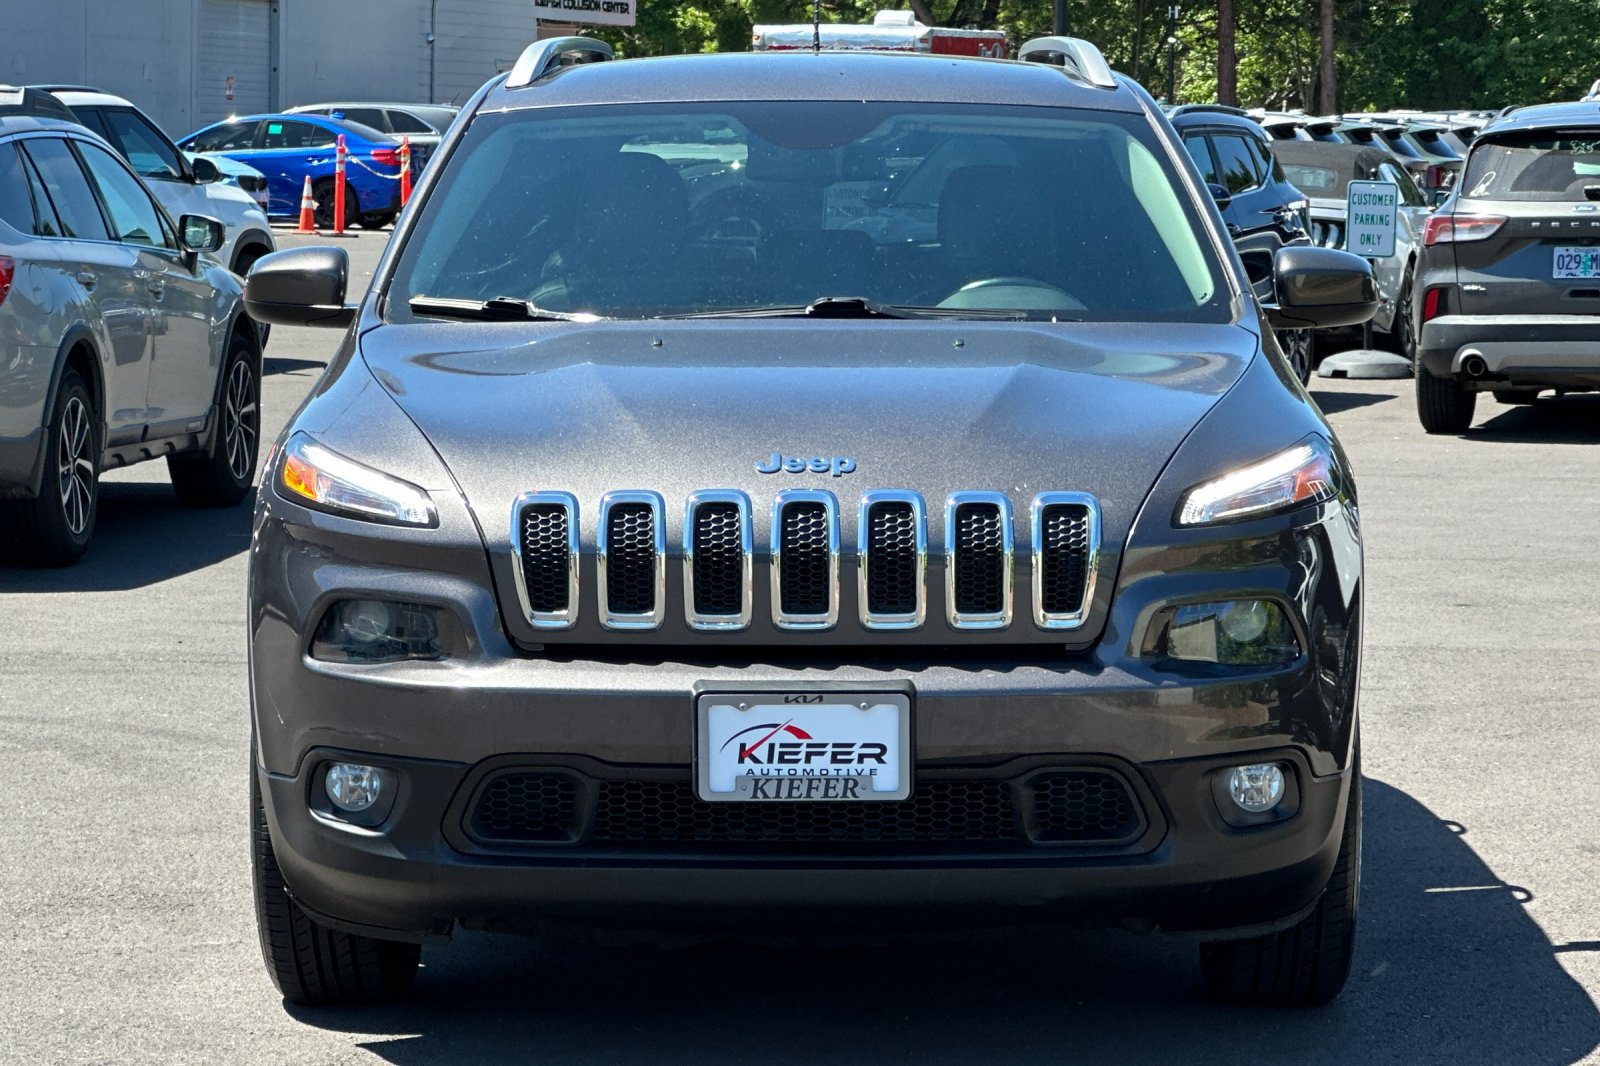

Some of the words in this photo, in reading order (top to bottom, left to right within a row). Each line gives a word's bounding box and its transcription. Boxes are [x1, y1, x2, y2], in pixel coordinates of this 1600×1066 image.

[601, 1, 630, 14] CENTER
[1351, 193, 1395, 207] CUSTOMER
[1354, 213, 1390, 226] PARKING
[1360, 233, 1382, 246] ONLY
[754, 452, 857, 477] Jeep
[737, 742, 888, 765] KIEFER
[746, 768, 878, 776] AUTOMOTIVE
[750, 777, 861, 800] KIEFER
